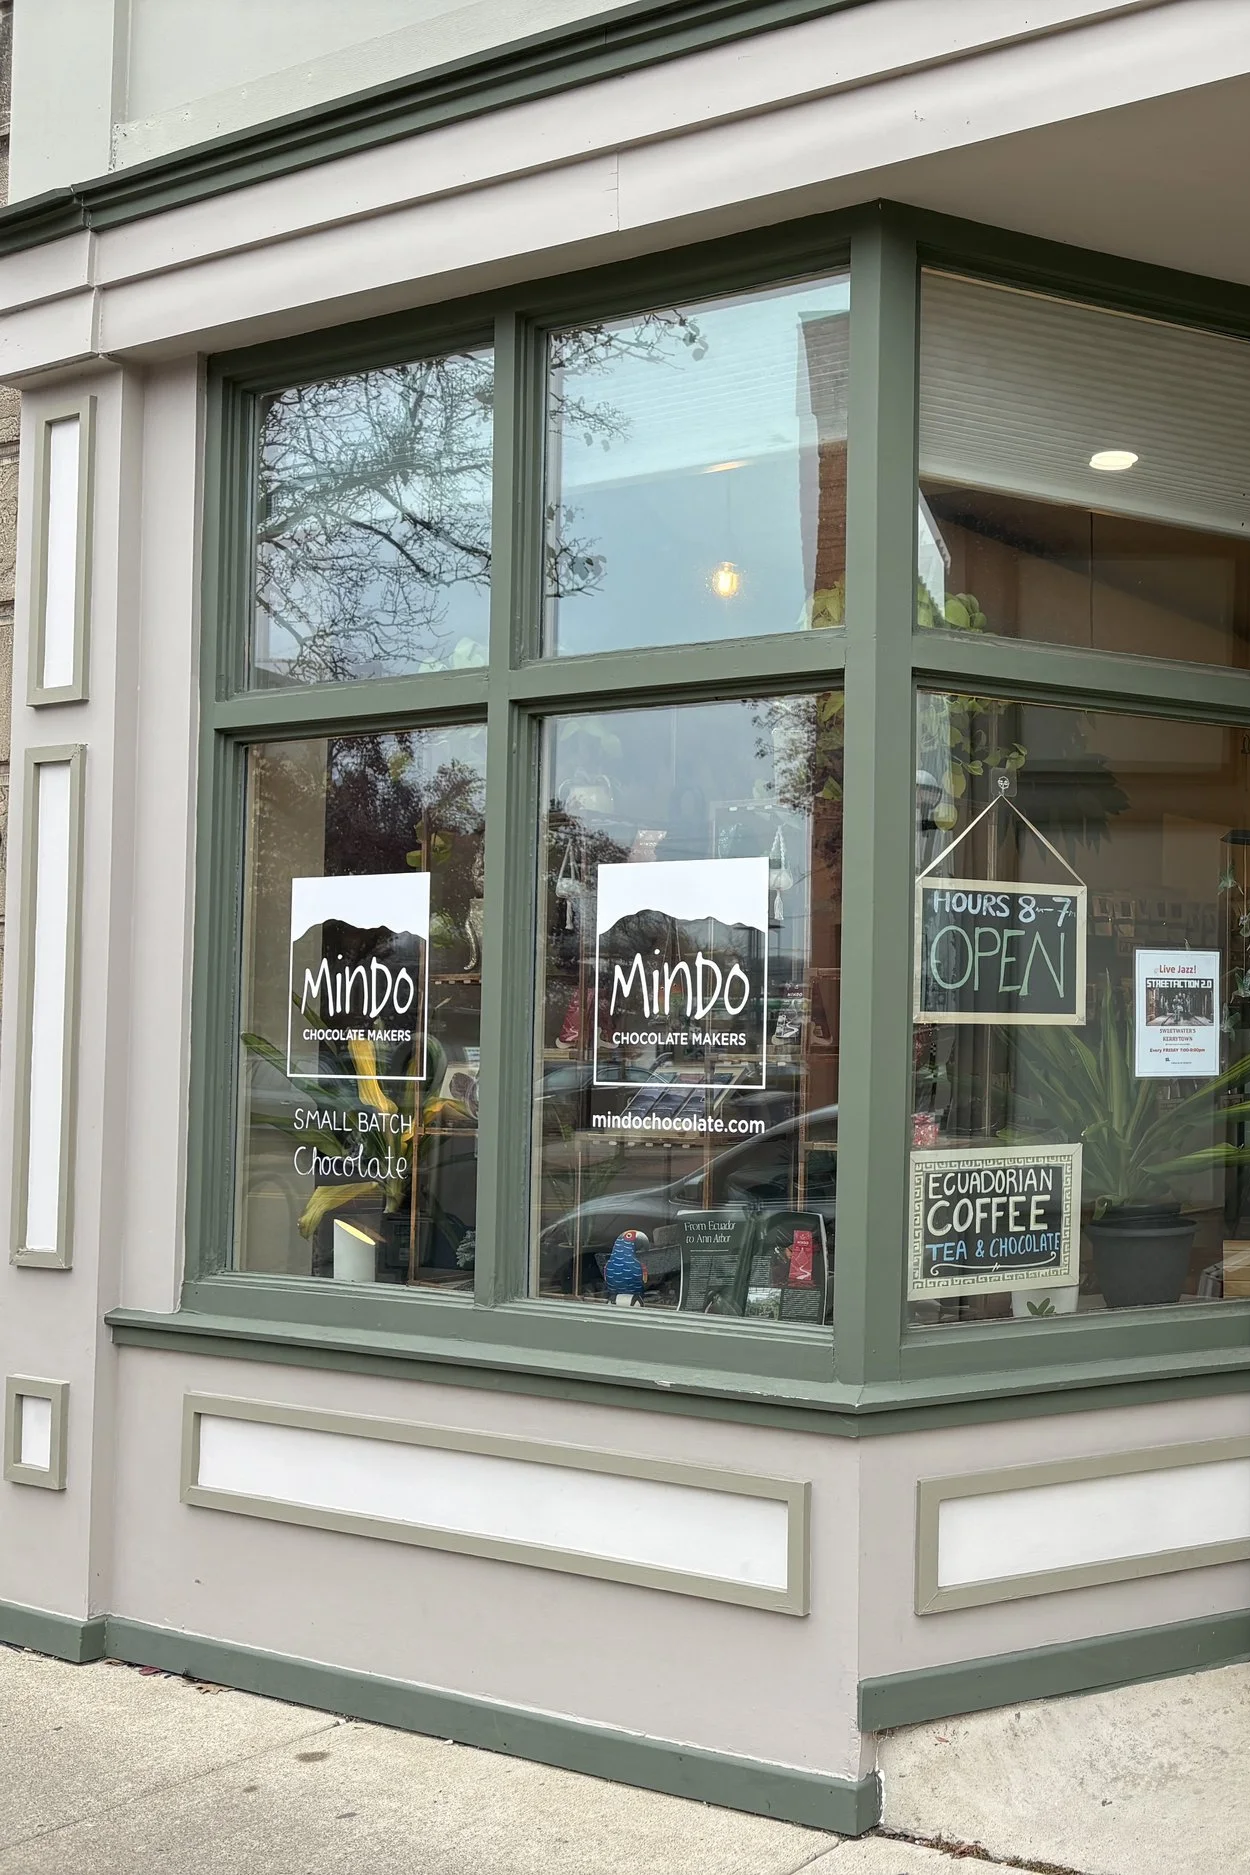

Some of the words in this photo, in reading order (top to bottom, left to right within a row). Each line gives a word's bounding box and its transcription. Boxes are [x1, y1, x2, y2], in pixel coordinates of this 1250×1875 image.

[932, 890, 1010, 918] HOURS
[930, 925, 1065, 999] OPEN
[1159, 964, 1176, 974] Live
[1177, 964, 1197, 975] Jazz!
[1200, 980, 1213, 989] 2.0
[303, 1029, 365, 1042] CHOCOLATE
[367, 1029, 411, 1042] MAKERS
[612, 1032, 689, 1046] CHOCOLATE
[692, 1032, 747, 1046] MAKERS
[293, 1108, 353, 1132] SMALL
[358, 1111, 413, 1135] BATCH
[592, 1111, 766, 1134] mindochocolate.com
[293, 1144, 409, 1180] Chocolate
[928, 1168, 1053, 1199] ECUADORIAN
[684, 1221, 706, 1232] From
[708, 1219, 737, 1231] Ecuador
[926, 1195, 1051, 1237] COFFEE
[686, 1236, 695, 1244] to
[697, 1234, 712, 1244] Ann
[925, 1240, 968, 1262] TEA
[974, 1239, 985, 1258] &
[989, 1232, 1061, 1258] CHOCOLATE
